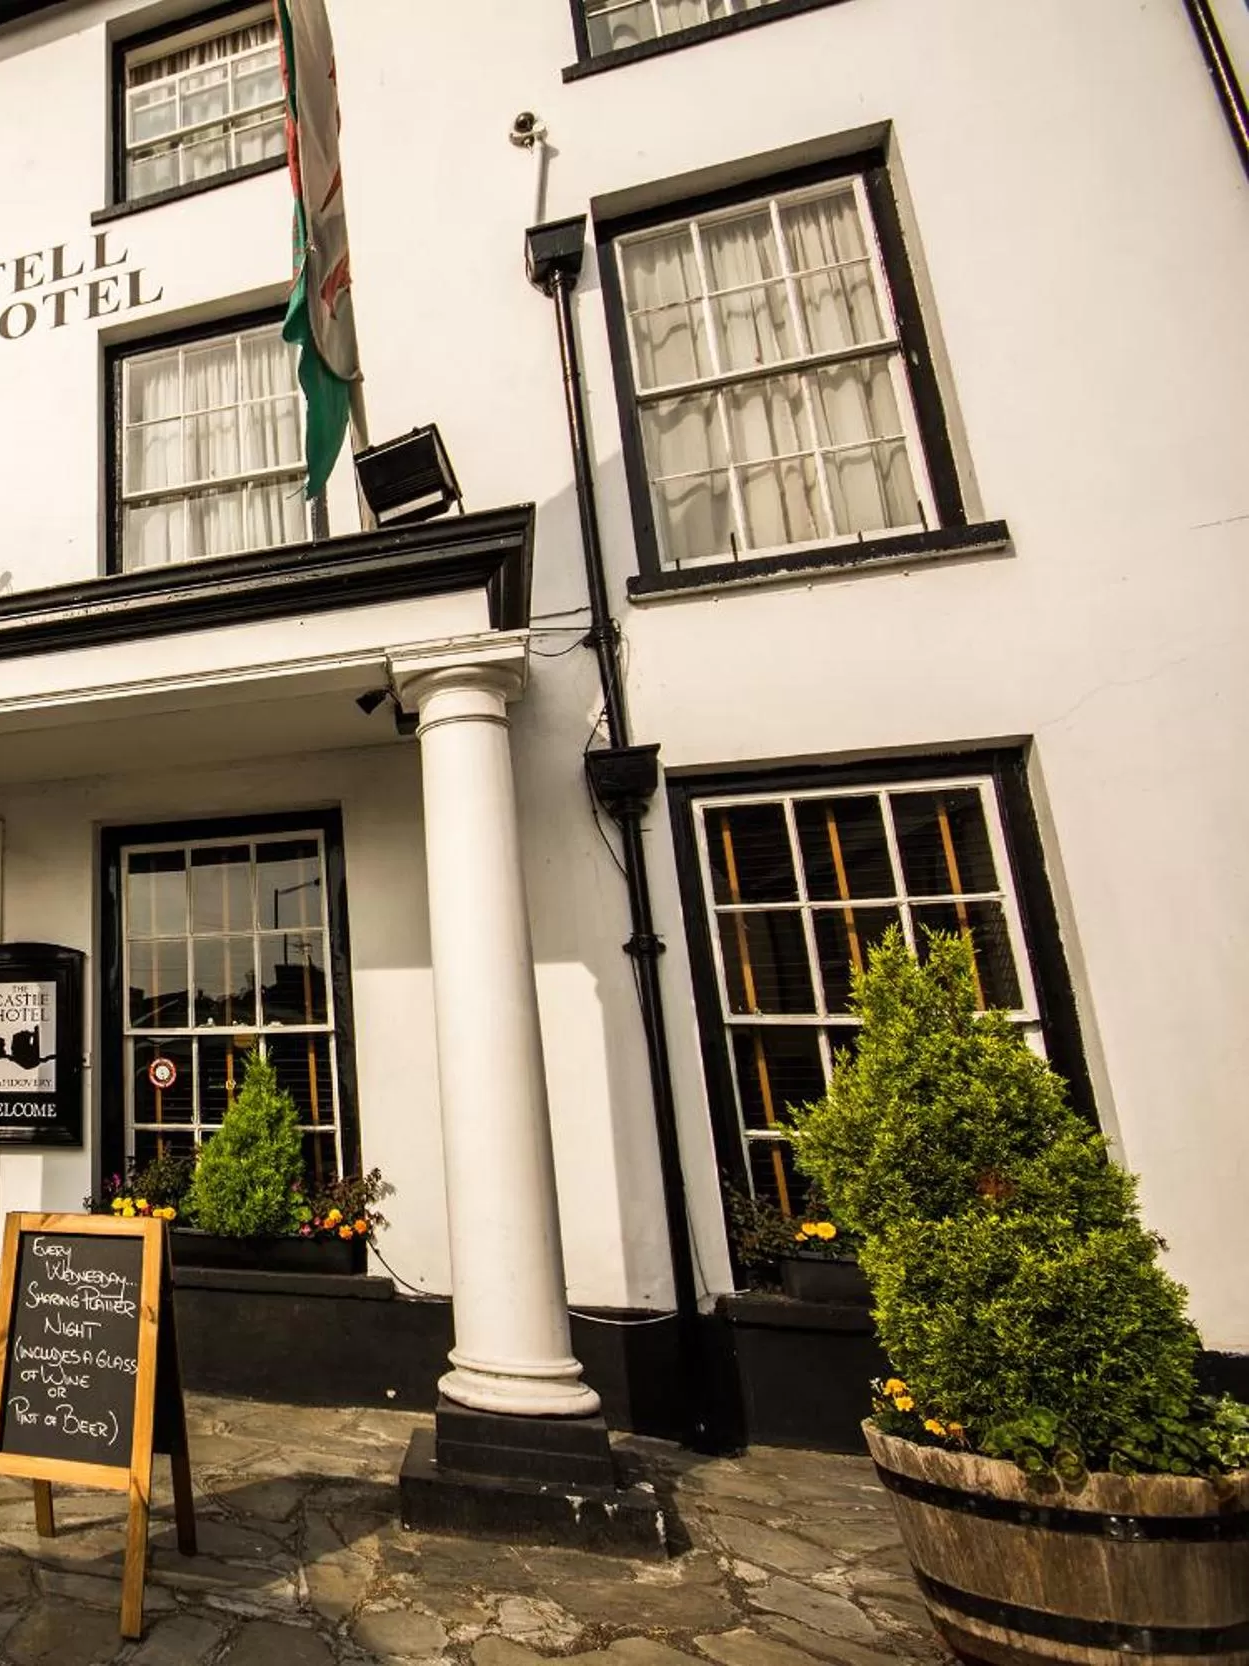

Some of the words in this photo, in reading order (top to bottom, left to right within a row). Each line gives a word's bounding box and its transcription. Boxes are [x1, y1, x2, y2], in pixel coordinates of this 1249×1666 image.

[82, 1350, 94, 1365] A
[20, 1369, 40, 1382] OF
[47, 1386, 68, 1398] OR
